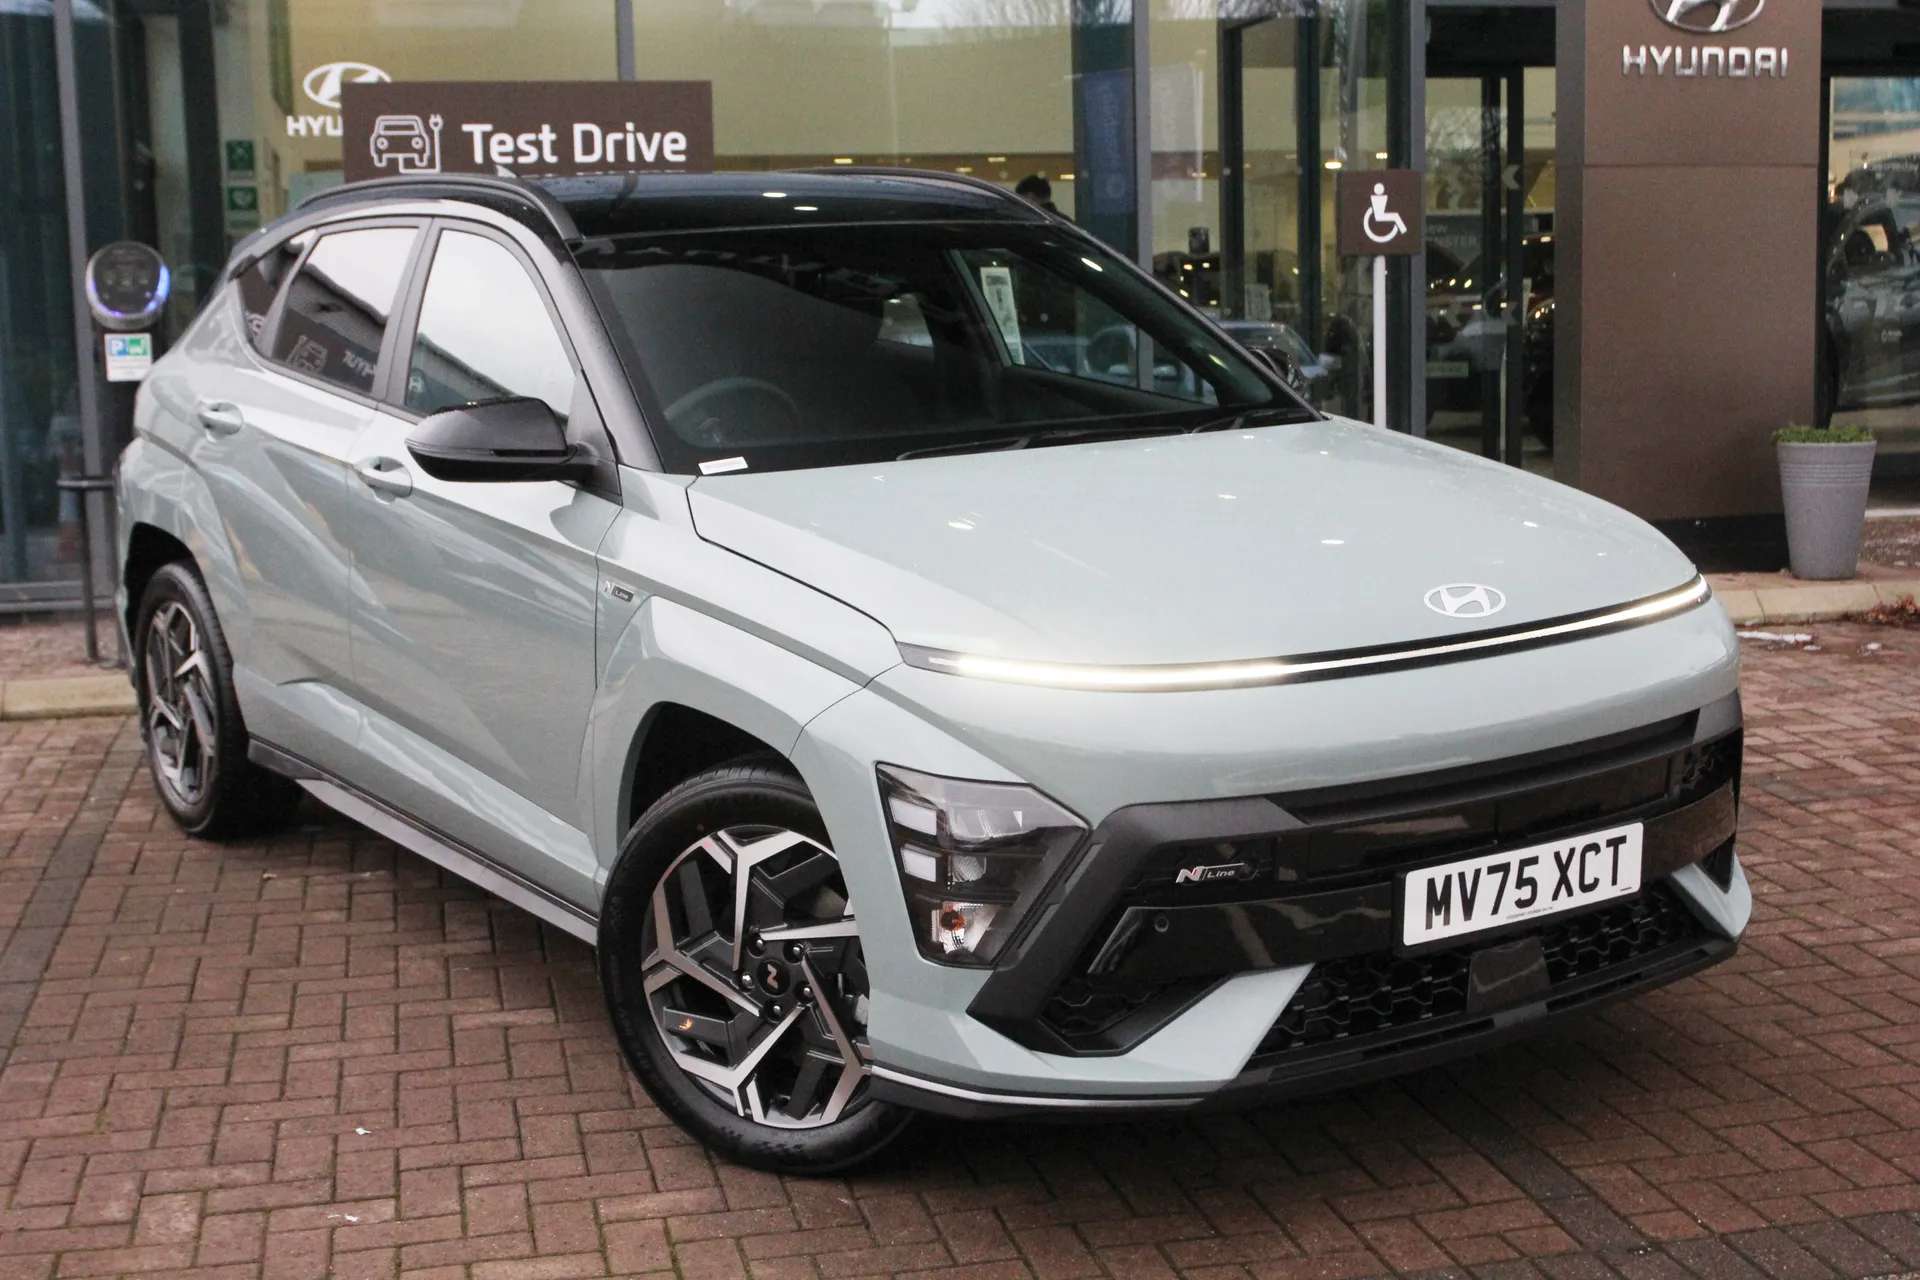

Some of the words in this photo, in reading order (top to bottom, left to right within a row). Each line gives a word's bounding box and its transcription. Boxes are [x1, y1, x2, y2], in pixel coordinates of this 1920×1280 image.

[1623, 45, 1788, 77] HYUNDAI
[461, 123, 559, 164] Test
[573, 122, 688, 163] Drive
[1207, 870, 1236, 878] Line
[1425, 855, 1539, 930] MV75
[1552, 835, 1627, 901] XCT
